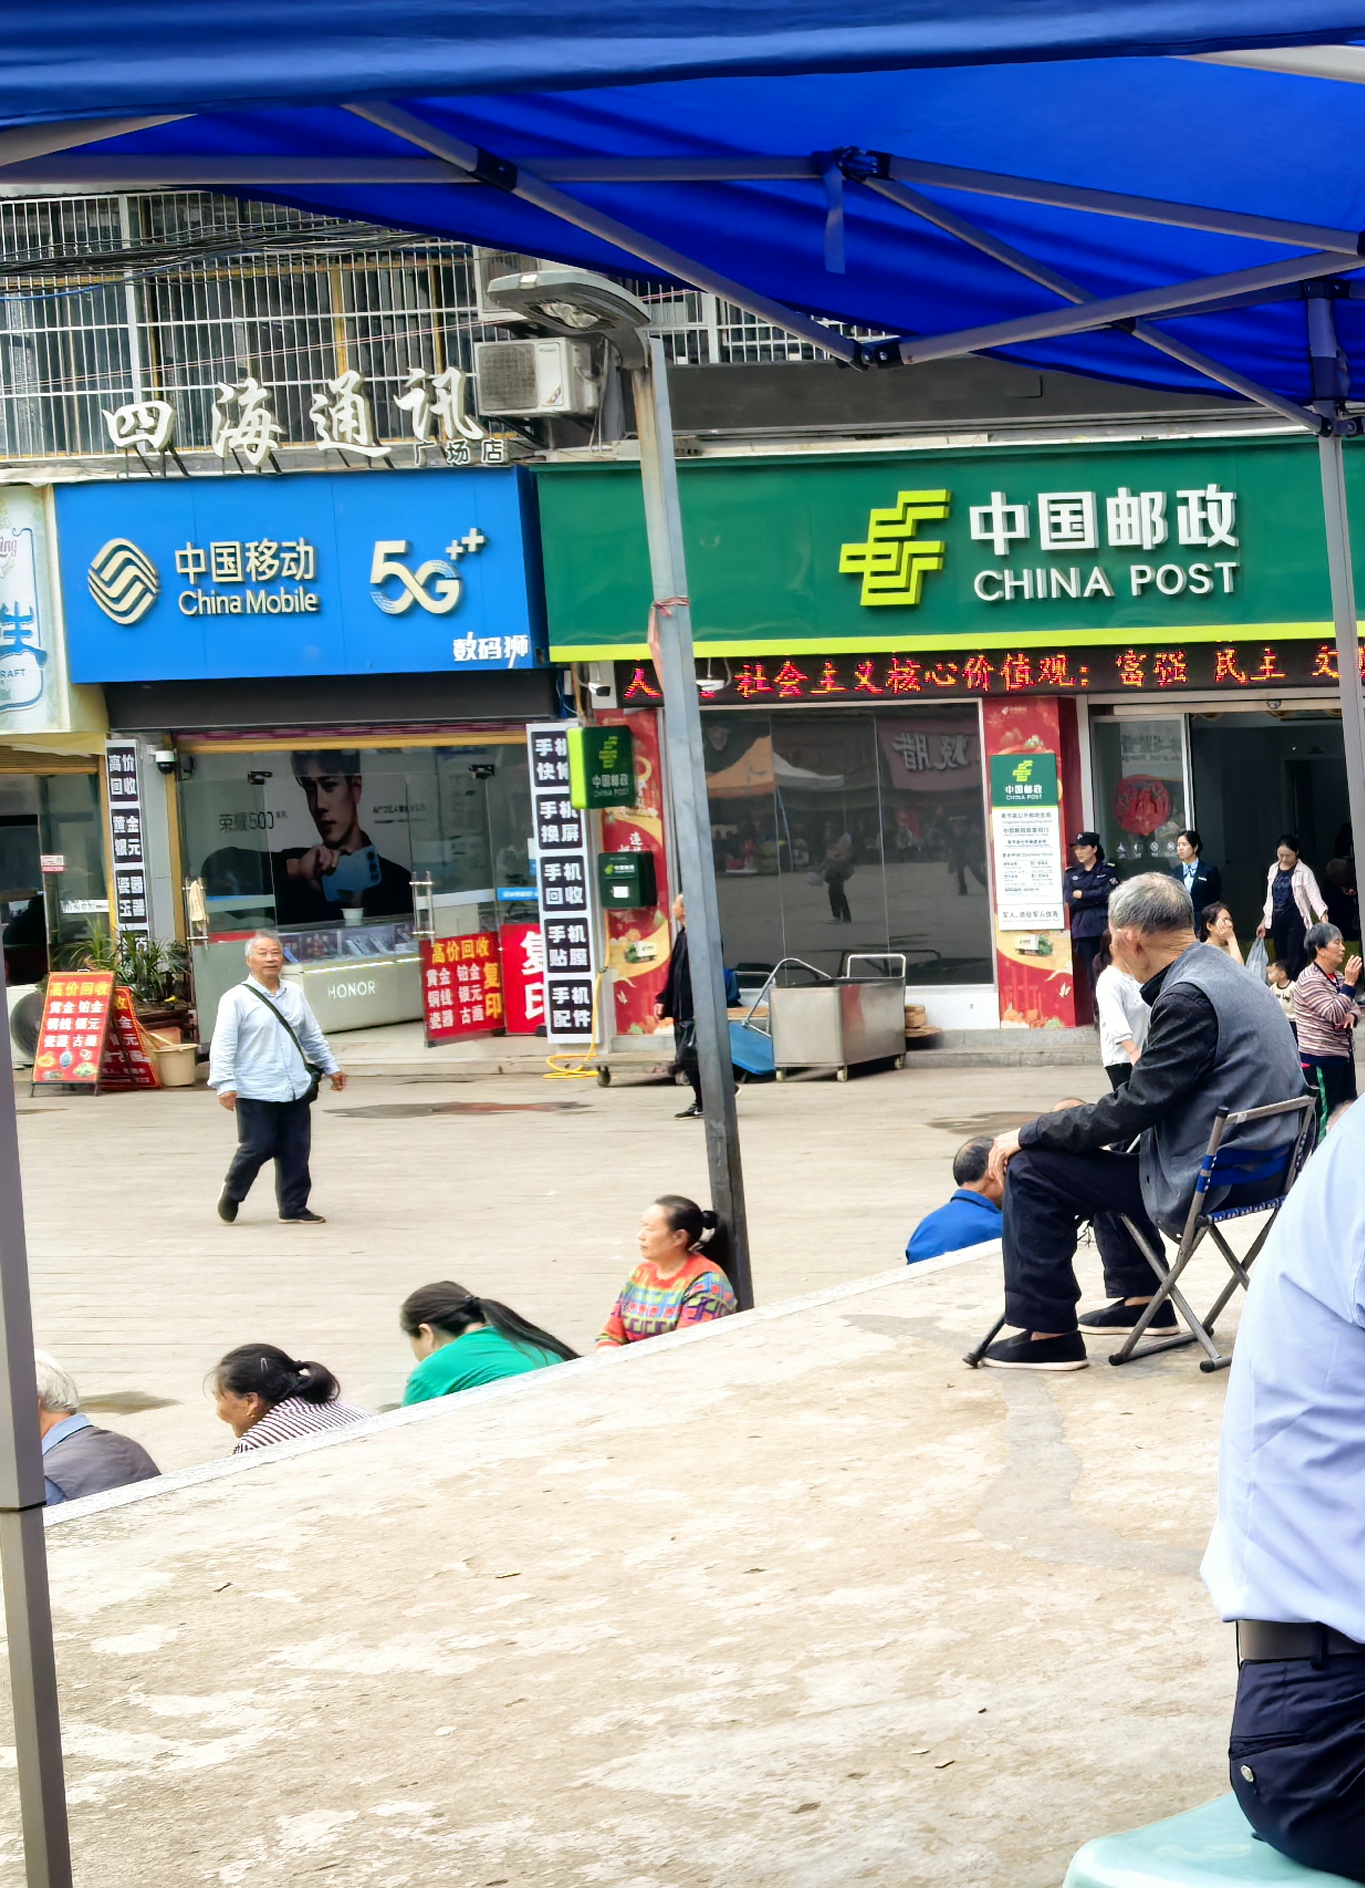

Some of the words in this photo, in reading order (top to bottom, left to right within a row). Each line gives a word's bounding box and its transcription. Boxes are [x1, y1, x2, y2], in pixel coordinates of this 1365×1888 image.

[103, 366, 486, 467] 四海通讯
[415, 439, 504, 466] 广场店
[970, 484, 1239, 556] 中国邮政
[175, 537, 316, 584] 中国移动
[973, 565, 1115, 601] CHINA
[1130, 562, 1240, 597] POST
[179, 589, 242, 616] China
[245, 585, 319, 615] Mobile
[453, 631, 529, 669] 数码狮
[1116, 647, 1190, 687] 富强
[1214, 640, 1286, 684] 民主
[535, 738, 567, 757] 手机
[108, 755, 135, 772] 高价
[110, 777, 137, 796] 回收
[1005, 784, 1043, 795] 中国邮政
[539, 801, 579, 820] 手机
[112, 815, 140, 833] 黄金
[540, 823, 580, 843] 换屏
[114, 838, 142, 857] 银元
[544, 862, 583, 881] 手机
[117, 876, 144, 895] 瓷器
[545, 886, 584, 905] 回收
[548, 925, 587, 943] 手机
[431, 936, 490, 965] 高价回收
[549, 948, 588, 967] 贴膜
[426, 967, 451, 987] 黄金
[456, 964, 481, 982] 铂金
[50, 982, 110, 997] 高价回收
[327, 980, 376, 1000] HONOR
[427, 988, 454, 1008] 铜线
[458, 984, 483, 1003] 银元
[483, 962, 503, 1019] 复印
[552, 987, 590, 1004] 手机
[429, 1010, 454, 1030] 瓷器
[460, 1005, 485, 1025] 古画
[553, 1009, 591, 1028] 配件
